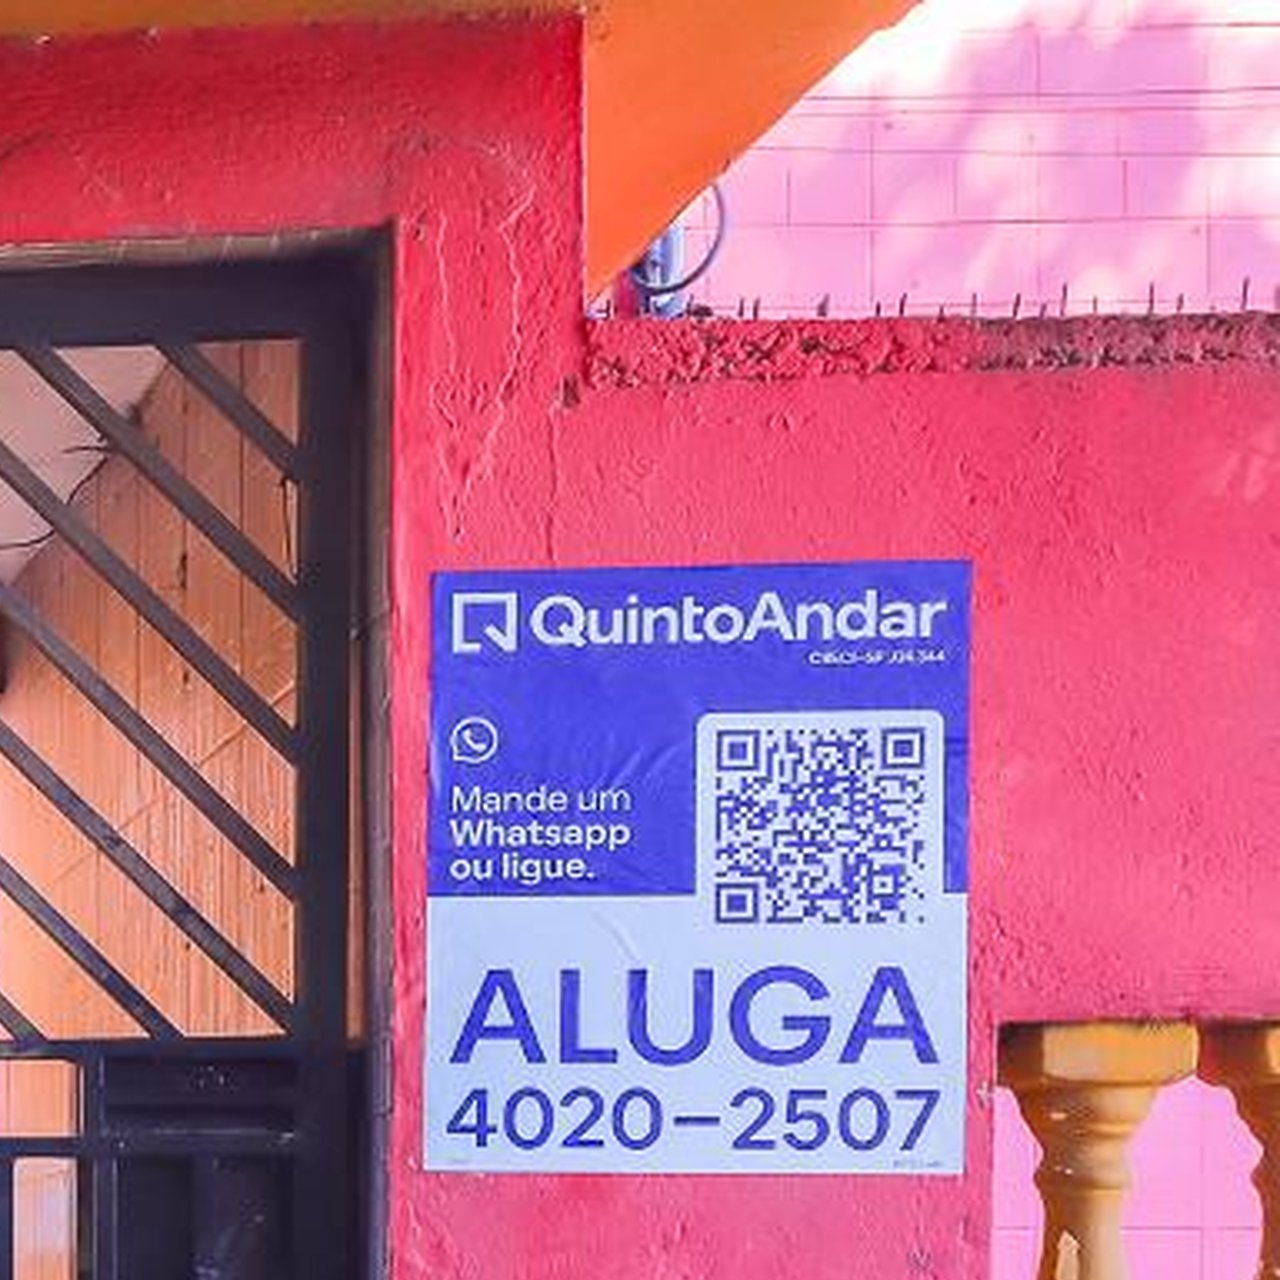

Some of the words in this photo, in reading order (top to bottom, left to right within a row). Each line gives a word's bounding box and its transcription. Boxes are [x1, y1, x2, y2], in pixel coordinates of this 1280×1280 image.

[529, 589, 948, 647] QuintoAndar
[450, 786, 568, 814] Mande
[578, 788, 631, 812] um
[450, 819, 631, 850] Whatsapp
[450, 857, 494, 881] ou
[502, 852, 596, 885] ligue.
[448, 965, 940, 1067] ALUGA
[446, 1086, 942, 1152] 4020-2507
